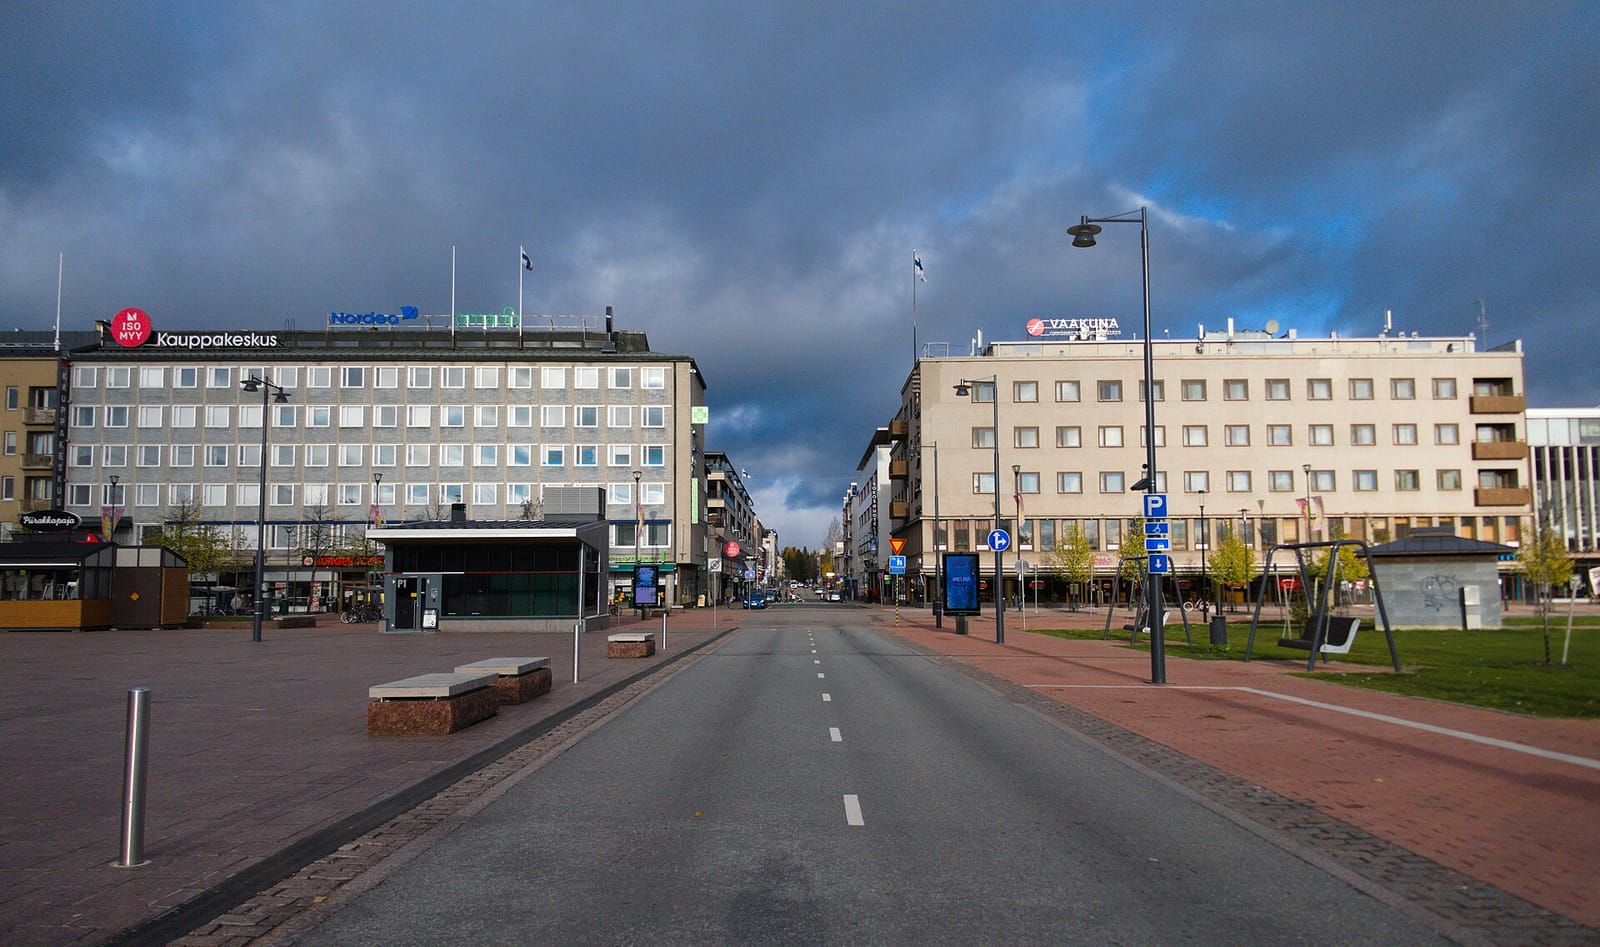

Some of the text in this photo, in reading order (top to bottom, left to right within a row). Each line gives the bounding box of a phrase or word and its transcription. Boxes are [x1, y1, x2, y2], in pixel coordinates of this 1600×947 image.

[331, 311, 399, 325] Nordea
[1049, 317, 1119, 329] VAAKUNA
[122, 322, 142, 331] ISO
[119, 331, 143, 341] MYY
[157, 332, 278, 349] Kauppakeskus
[56, 371, 68, 507] KAUPPAKESKUS
[1147, 495, 1163, 517] P
[23, 515, 75, 526] Piirakkapaja
[397, 578, 407, 589] P1
